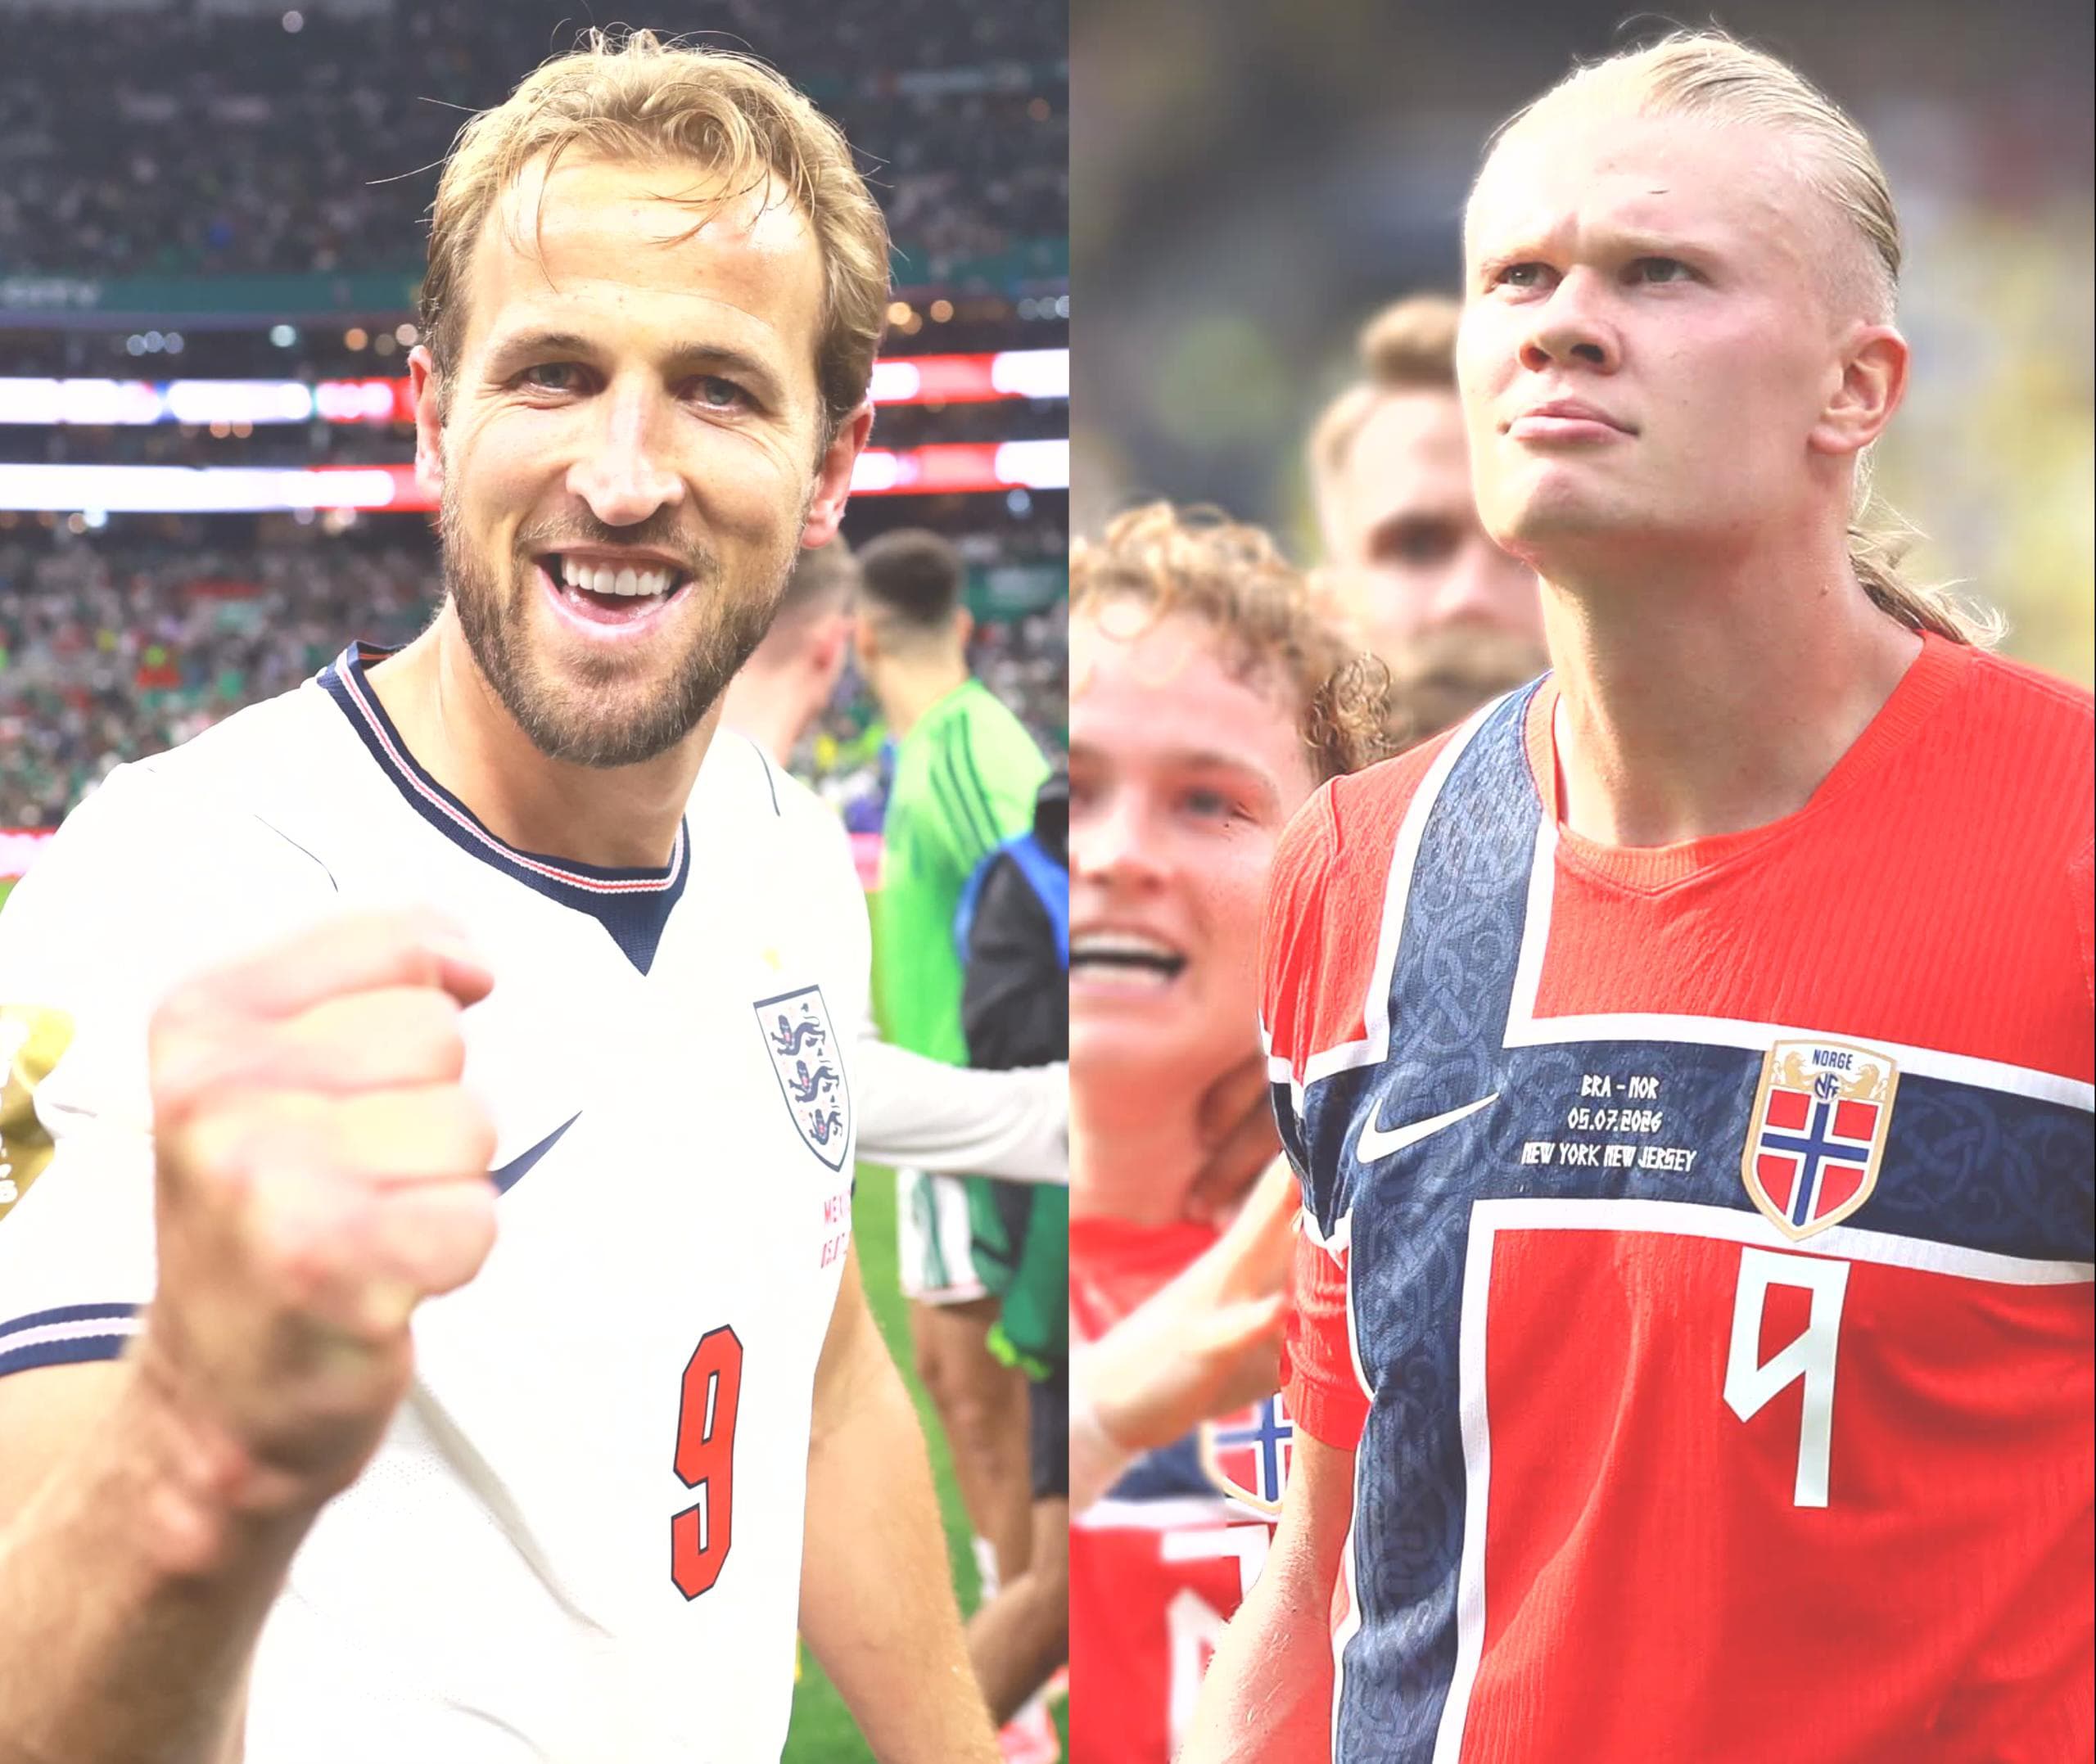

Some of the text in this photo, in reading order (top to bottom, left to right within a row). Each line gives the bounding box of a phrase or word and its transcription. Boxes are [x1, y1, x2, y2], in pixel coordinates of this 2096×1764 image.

[1812, 1049, 1854, 1071] NORGE
[1581, 1074, 1611, 1098] BRA
[1628, 1076, 1660, 1099] NOR
[1567, 1107, 1663, 1133] 05.07.2026
[1520, 1141, 1697, 1172] NEW YORK NEW JERSEY
[1723, 1245, 1851, 1508] 9
[672, 1323, 743, 1602] 9
